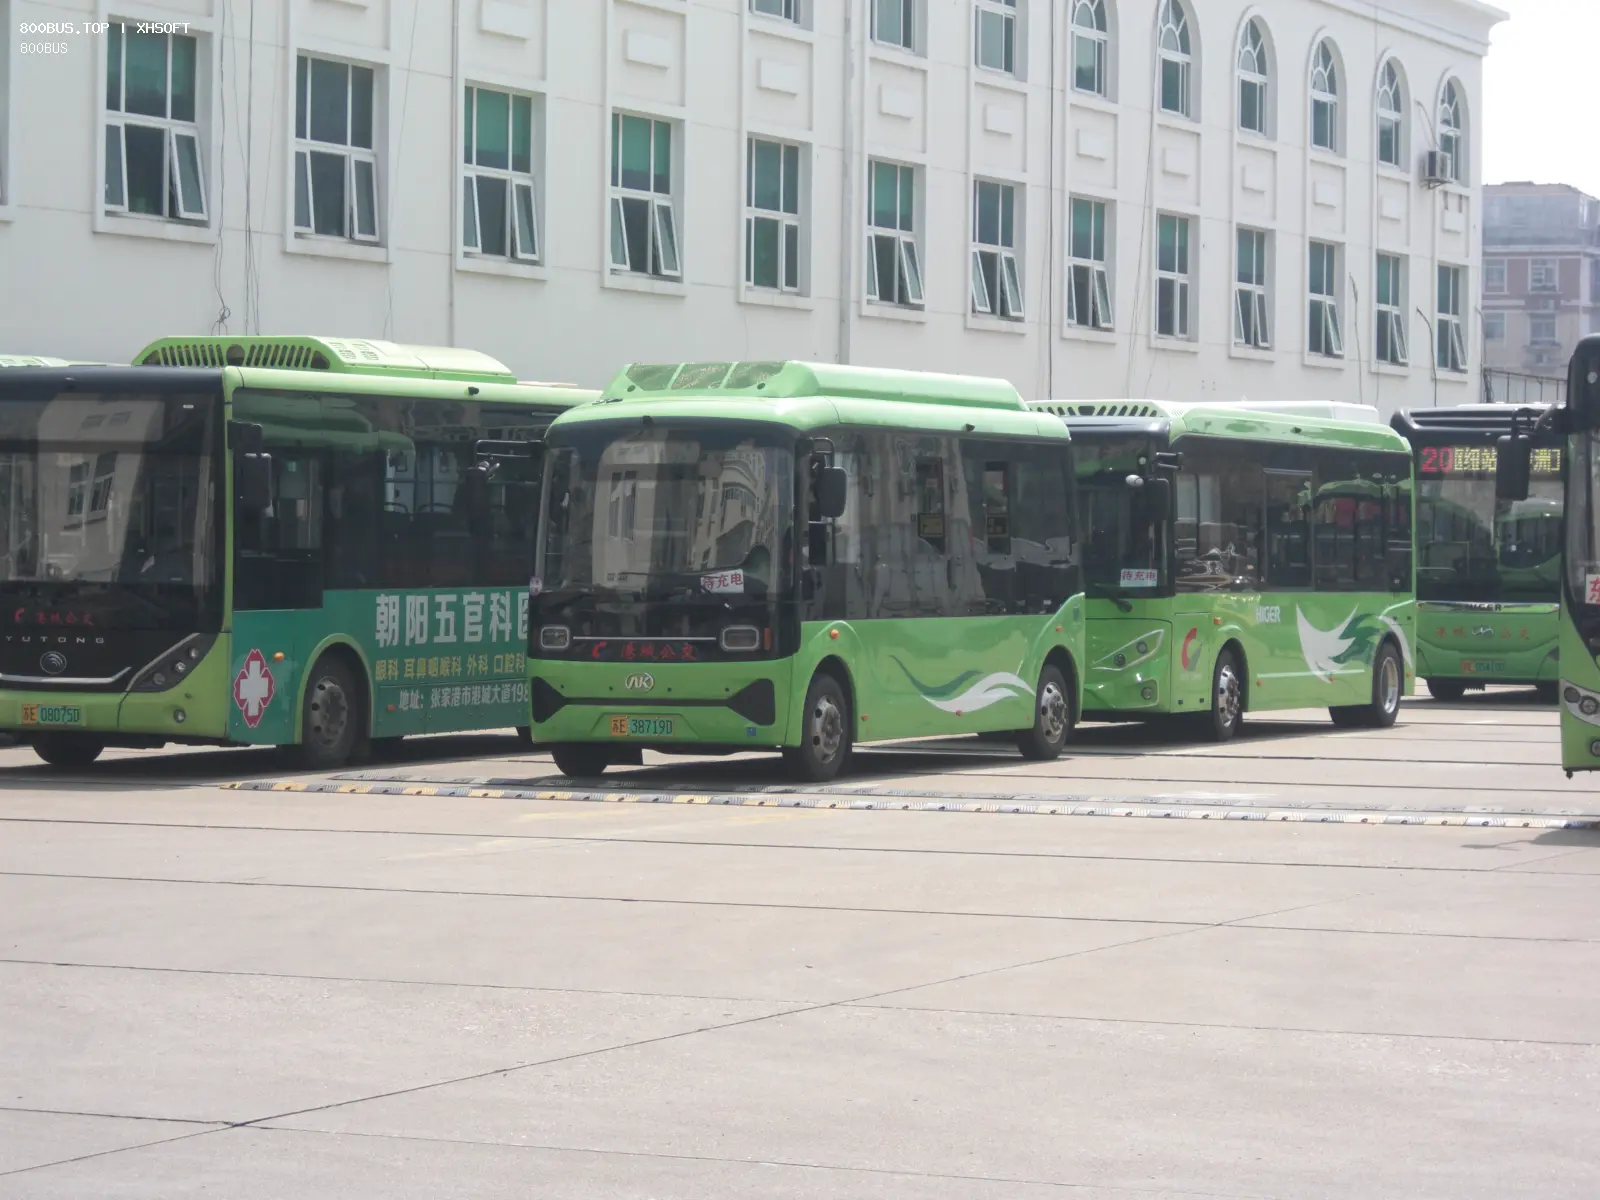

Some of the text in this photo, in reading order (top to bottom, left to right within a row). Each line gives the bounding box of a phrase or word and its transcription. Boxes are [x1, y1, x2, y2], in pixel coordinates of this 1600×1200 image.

[1421, 447, 1452, 472] 20
[1122, 571, 1157, 581] 待充电
[1256, 605, 1281, 623] HIGER
[6, 635, 105, 644] YUTONG
[375, 651, 526, 681] 眼科 耳鼻咽喉科 外科 口腔科
[631, 719, 673, 734] 38719D
